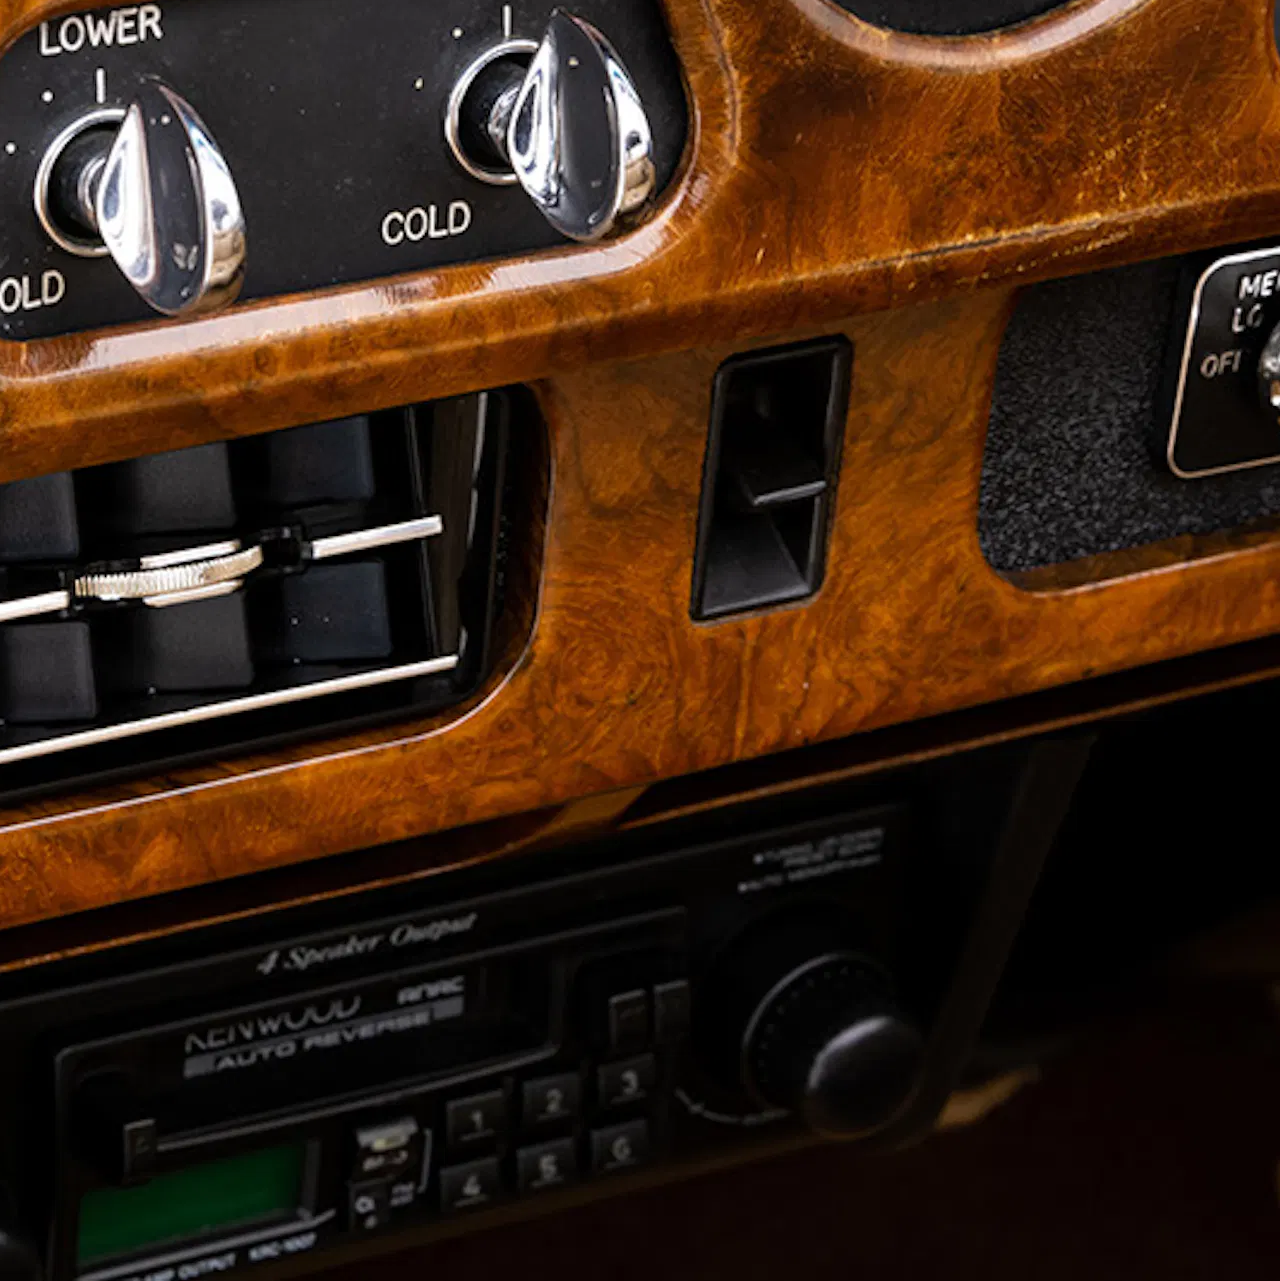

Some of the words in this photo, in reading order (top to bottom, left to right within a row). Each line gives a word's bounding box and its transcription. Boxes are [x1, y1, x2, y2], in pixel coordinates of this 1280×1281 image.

[39, 4, 163, 56] LOWER
[381, 201, 472, 246] COLD
[255, 951, 280, 976] 4
[283, 933, 388, 971] Speaker
[390, 911, 479, 947] Output
[184, 994, 363, 1055] KENWOOD
[214, 1039, 298, 1072] AUTO
[302, 1009, 431, 1052] REVERSE
[545, 1088, 563, 1113] 2
[621, 1069, 640, 1096] 3
[471, 1109, 485, 1132] 1
[538, 1153, 558, 1181] 5
[462, 1174, 481, 1197] 4
